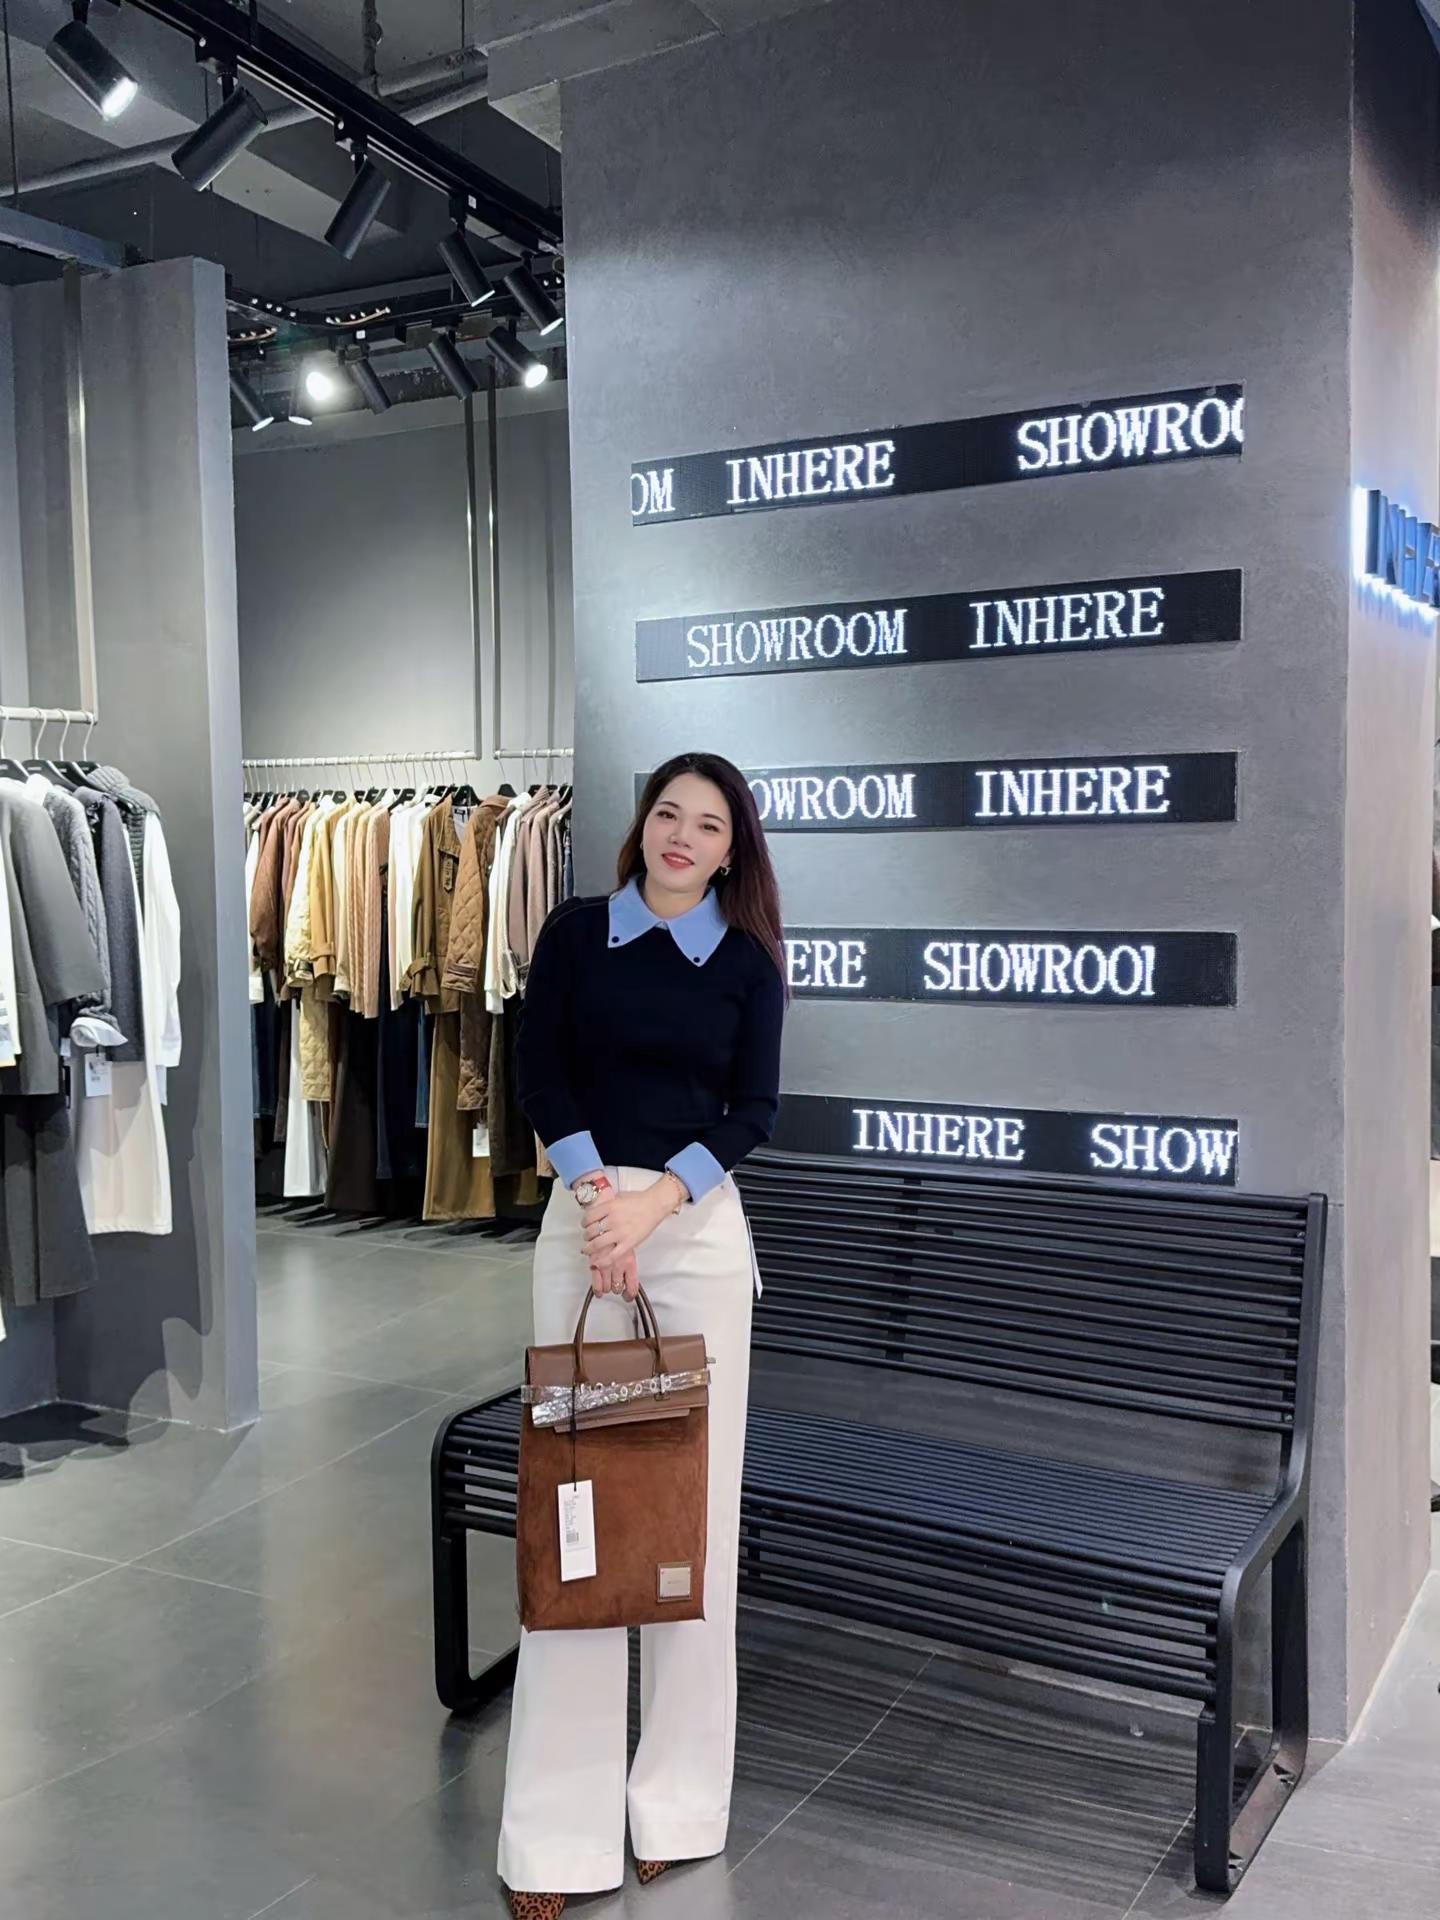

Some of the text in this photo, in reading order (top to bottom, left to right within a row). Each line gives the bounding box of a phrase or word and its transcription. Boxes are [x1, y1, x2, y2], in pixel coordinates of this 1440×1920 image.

[726, 440, 895, 504] INHERE
[687, 587, 1164, 668] SHOWROOM INHERE
[975, 765, 1170, 817] INHERE
[853, 1109, 1238, 1176] INHERE SHOW
